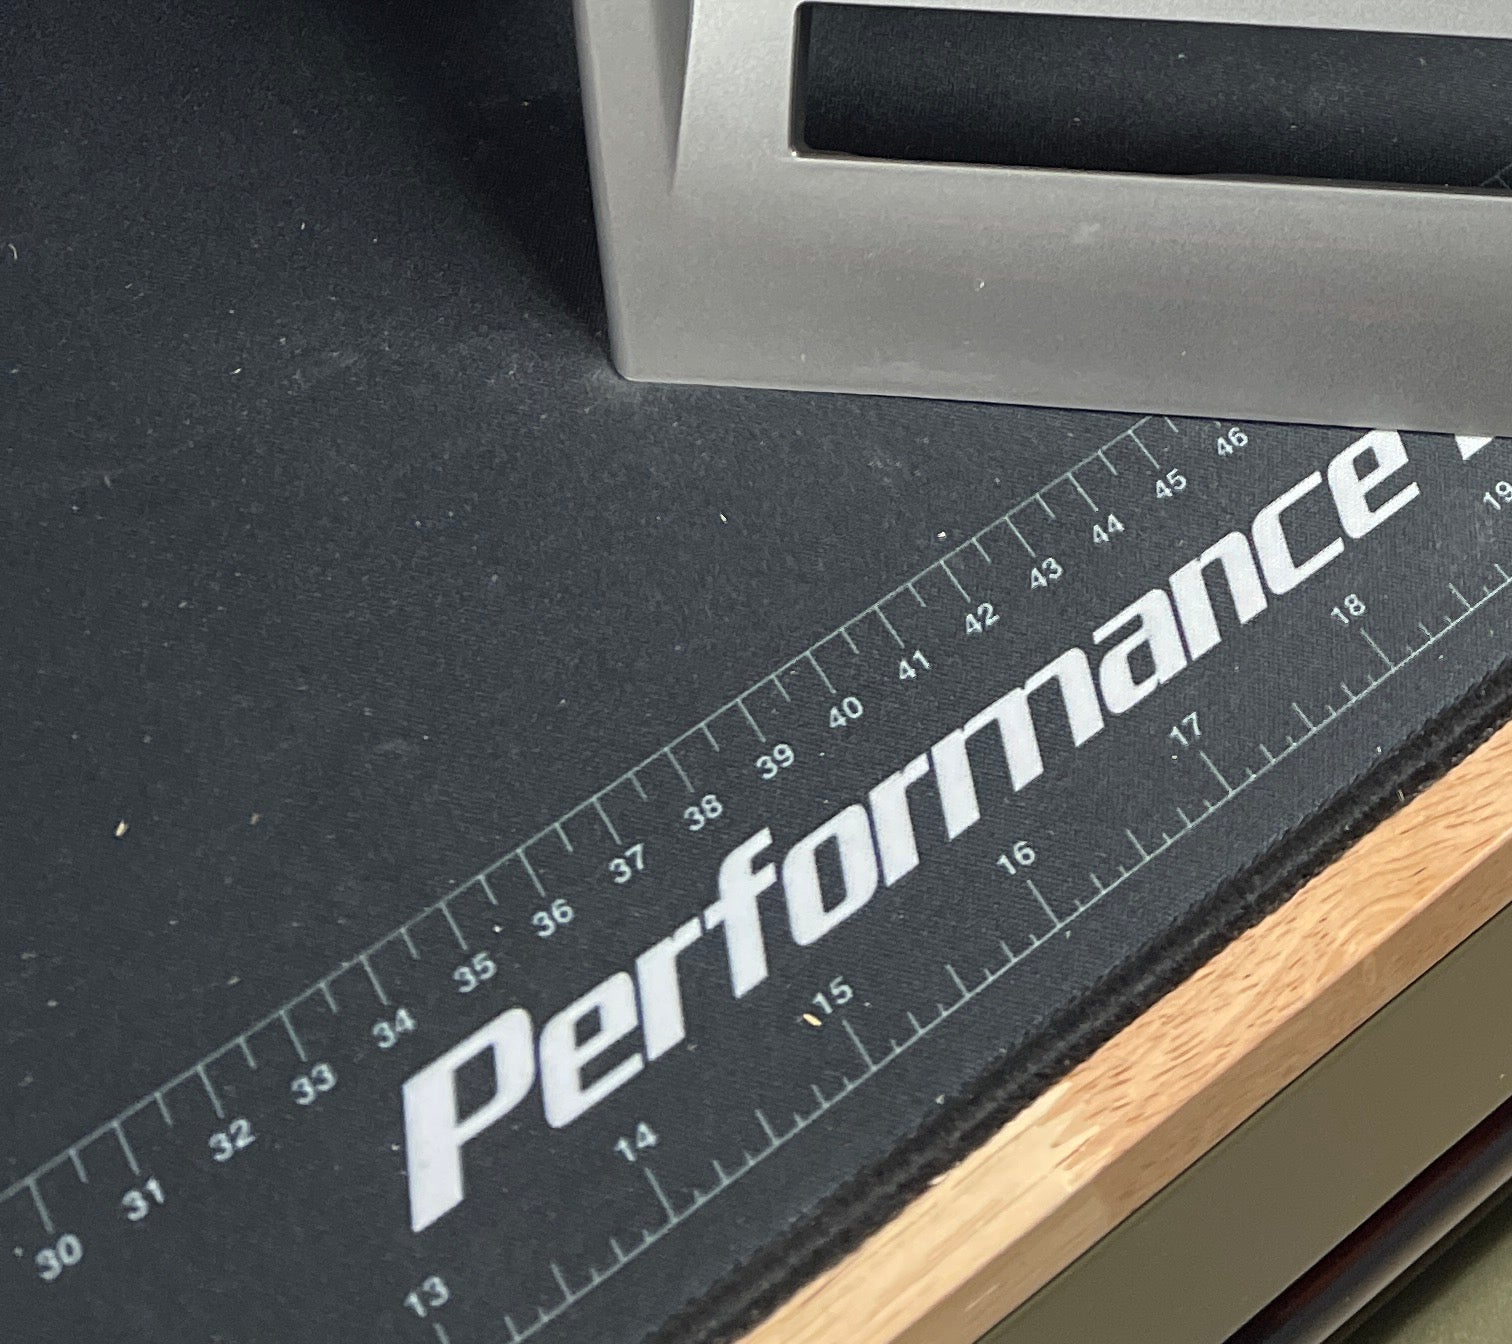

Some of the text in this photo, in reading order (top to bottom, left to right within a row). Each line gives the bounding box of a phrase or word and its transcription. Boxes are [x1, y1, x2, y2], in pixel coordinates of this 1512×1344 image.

[1216, 427, 1249, 459] 46
[1154, 469, 1187, 499] 45
[1092, 514, 1124, 546] 44
[1027, 557, 1063, 590] 43
[964, 602, 1000, 637] 42
[1330, 593, 1368, 627] 18
[897, 649, 930, 682] 41
[827, 696, 864, 730] 40
[1168, 712, 1203, 748] 17
[755, 744, 795, 780] 39
[402, 429, 1420, 1231] Performance
[684, 794, 723, 832] 38
[608, 843, 646, 883] 37
[996, 841, 1037, 875] 16
[532, 898, 574, 937] 36
[453, 952, 497, 993] 35
[813, 975, 856, 1016] 15
[372, 1008, 417, 1049] 34
[291, 1063, 337, 1105] 33
[209, 1119, 256, 1162] 32
[613, 1120, 659, 1164] 14
[120, 1177, 164, 1220] 31
[35, 1235, 83, 1280] 30
[404, 1275, 450, 1319] 13
